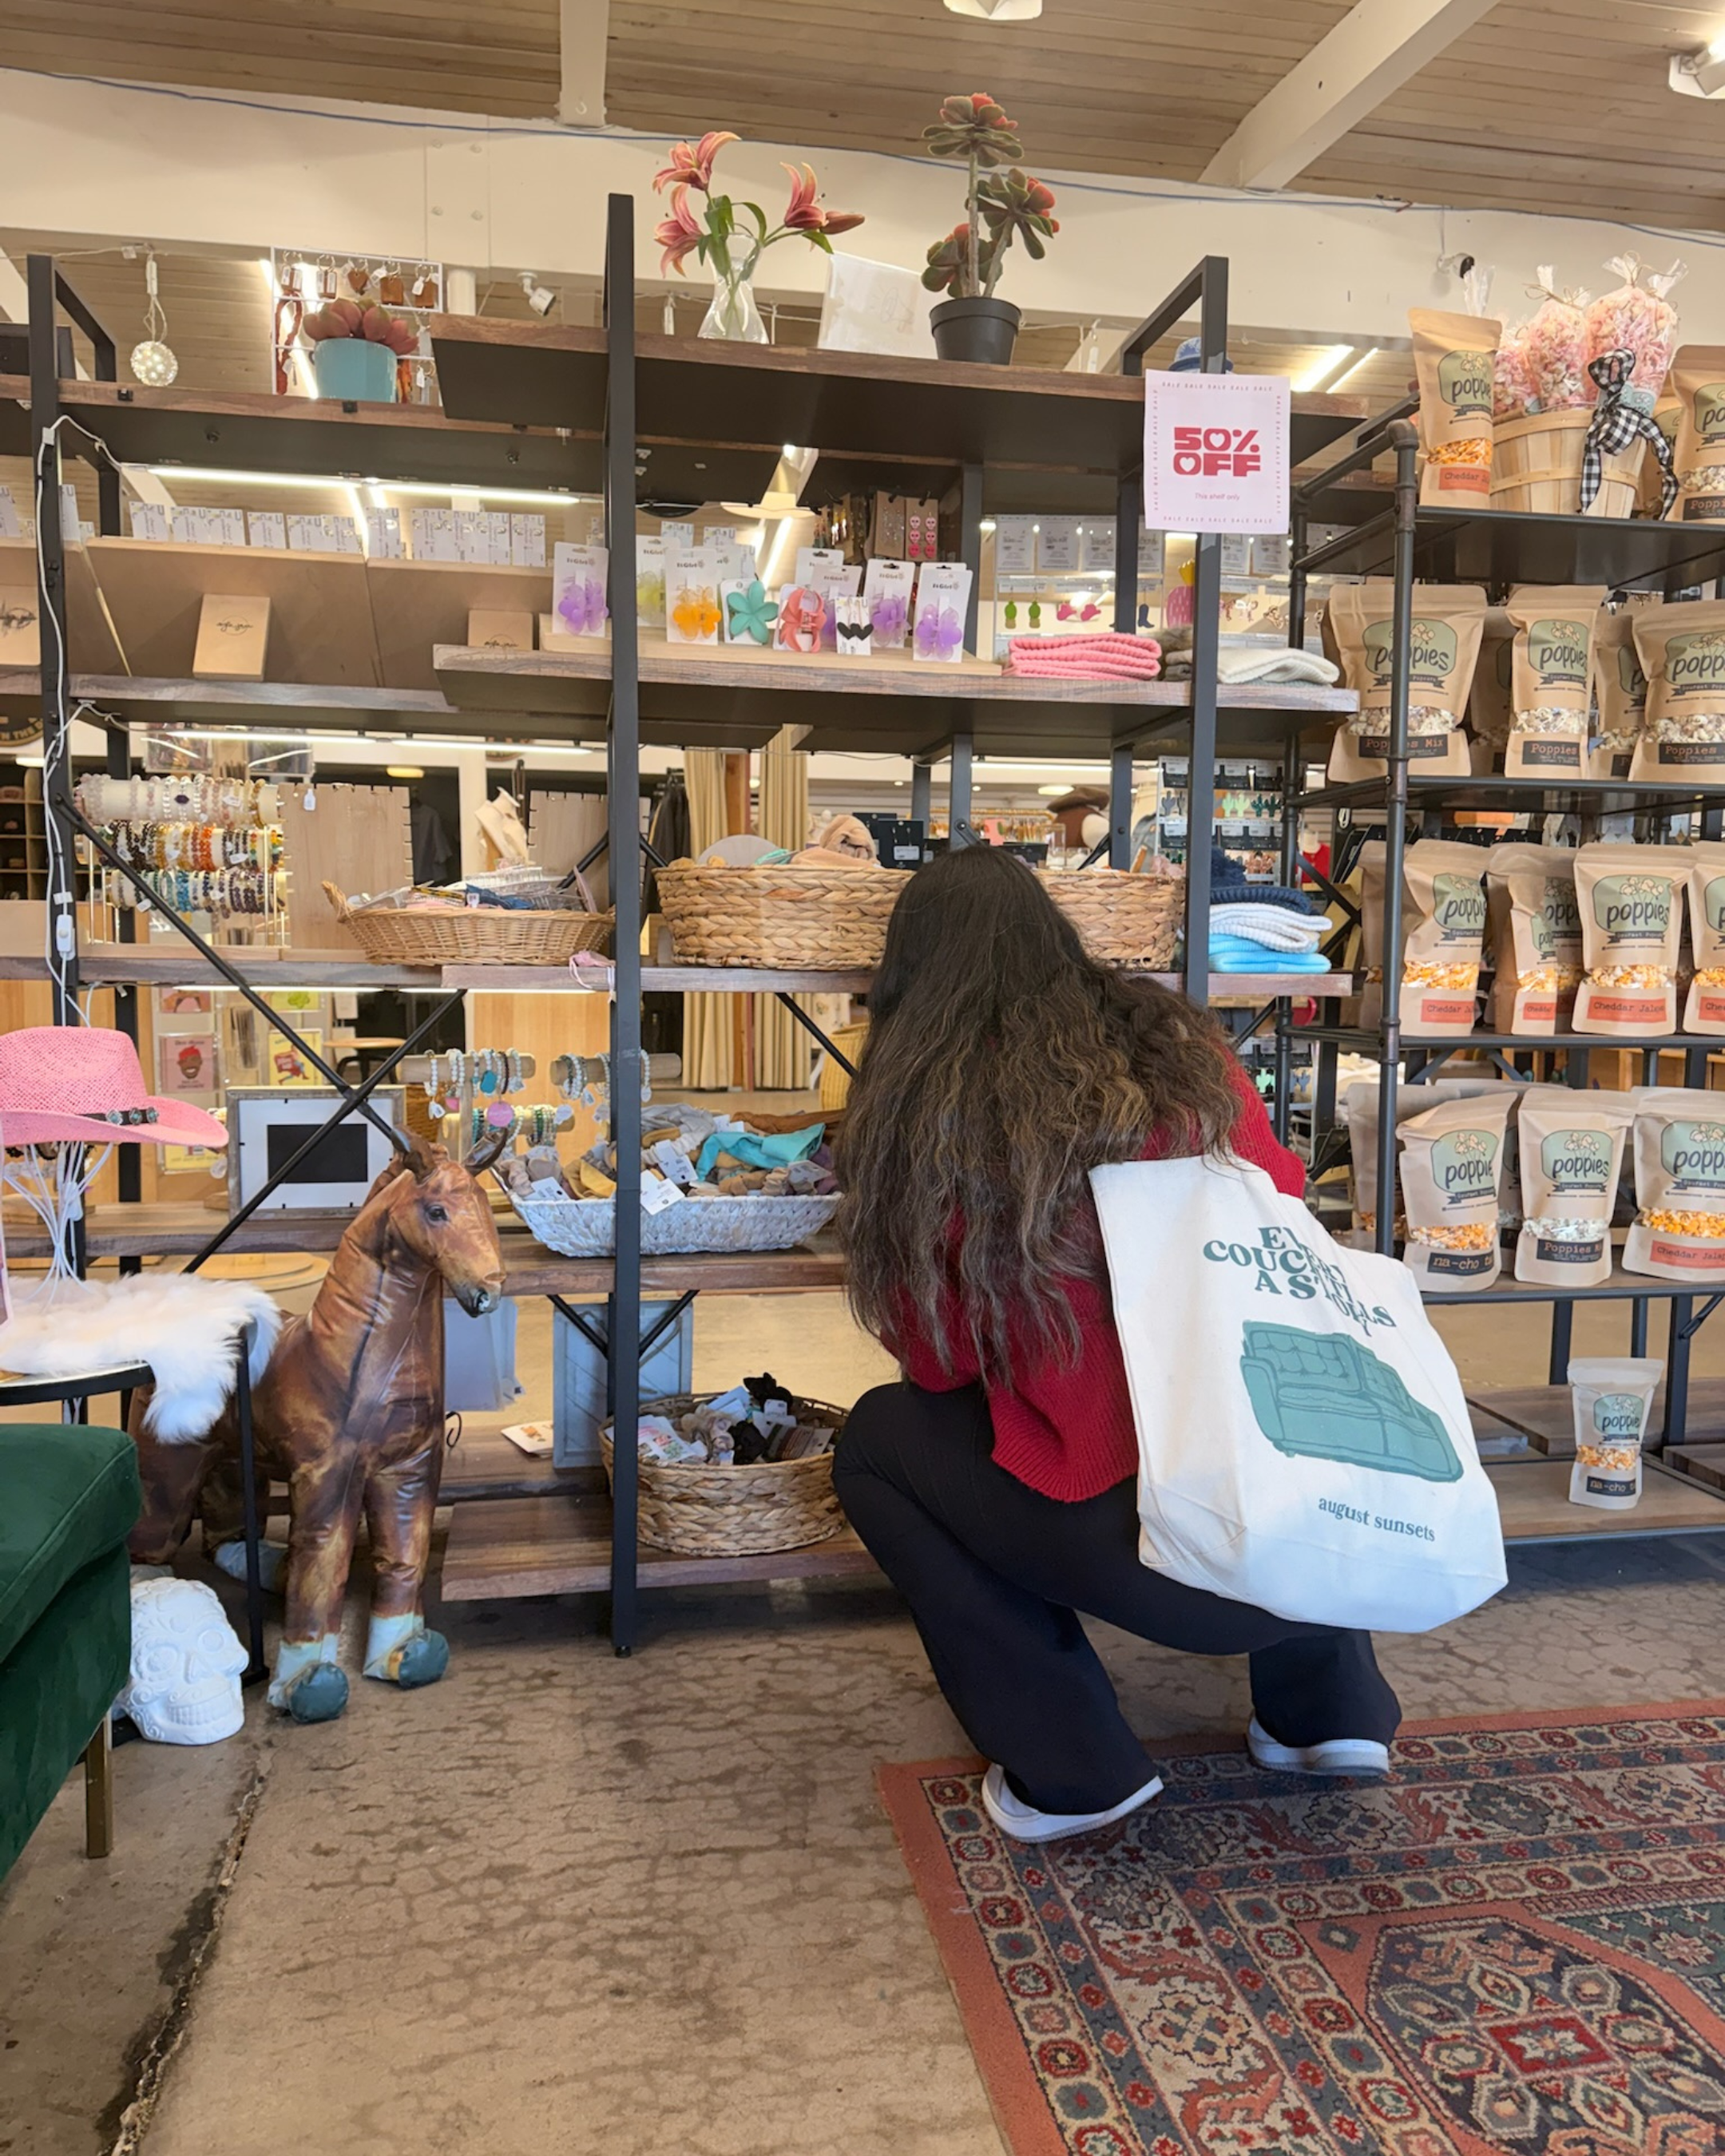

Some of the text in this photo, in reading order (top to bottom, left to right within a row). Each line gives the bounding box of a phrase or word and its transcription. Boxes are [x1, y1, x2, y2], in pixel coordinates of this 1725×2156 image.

[1452, 378, 1491, 403] popp
[1174, 426, 1260, 453] 50%
[1173, 452, 1261, 478] OFF
[1445, 471, 1479, 481] Cheddar
[1374, 645, 1449, 672] ppies
[1672, 654, 1725, 681] popp
[1366, 738, 1444, 749] Pops Mix
[1530, 743, 1577, 757] Poppies
[1665, 745, 1717, 759] Poppies
[1607, 901, 1670, 929] poppies
[1426, 1004, 1461, 1014] Cheddar
[1593, 1001, 1634, 1012] Cheddar
[1552, 1156, 1609, 1179] poppies
[1673, 1148, 1725, 1175] popp
[1204, 1240, 1308, 1275] COUC
[1545, 1242, 1592, 1254] Poppies
[1657, 1246, 1699, 1259] Cheddar
[1433, 1256, 1480, 1270] na-cho
[1255, 1270, 1283, 1295] A
[1589, 1480, 1626, 1492] na-cho
[1318, 1496, 1436, 1543] august sunsets
